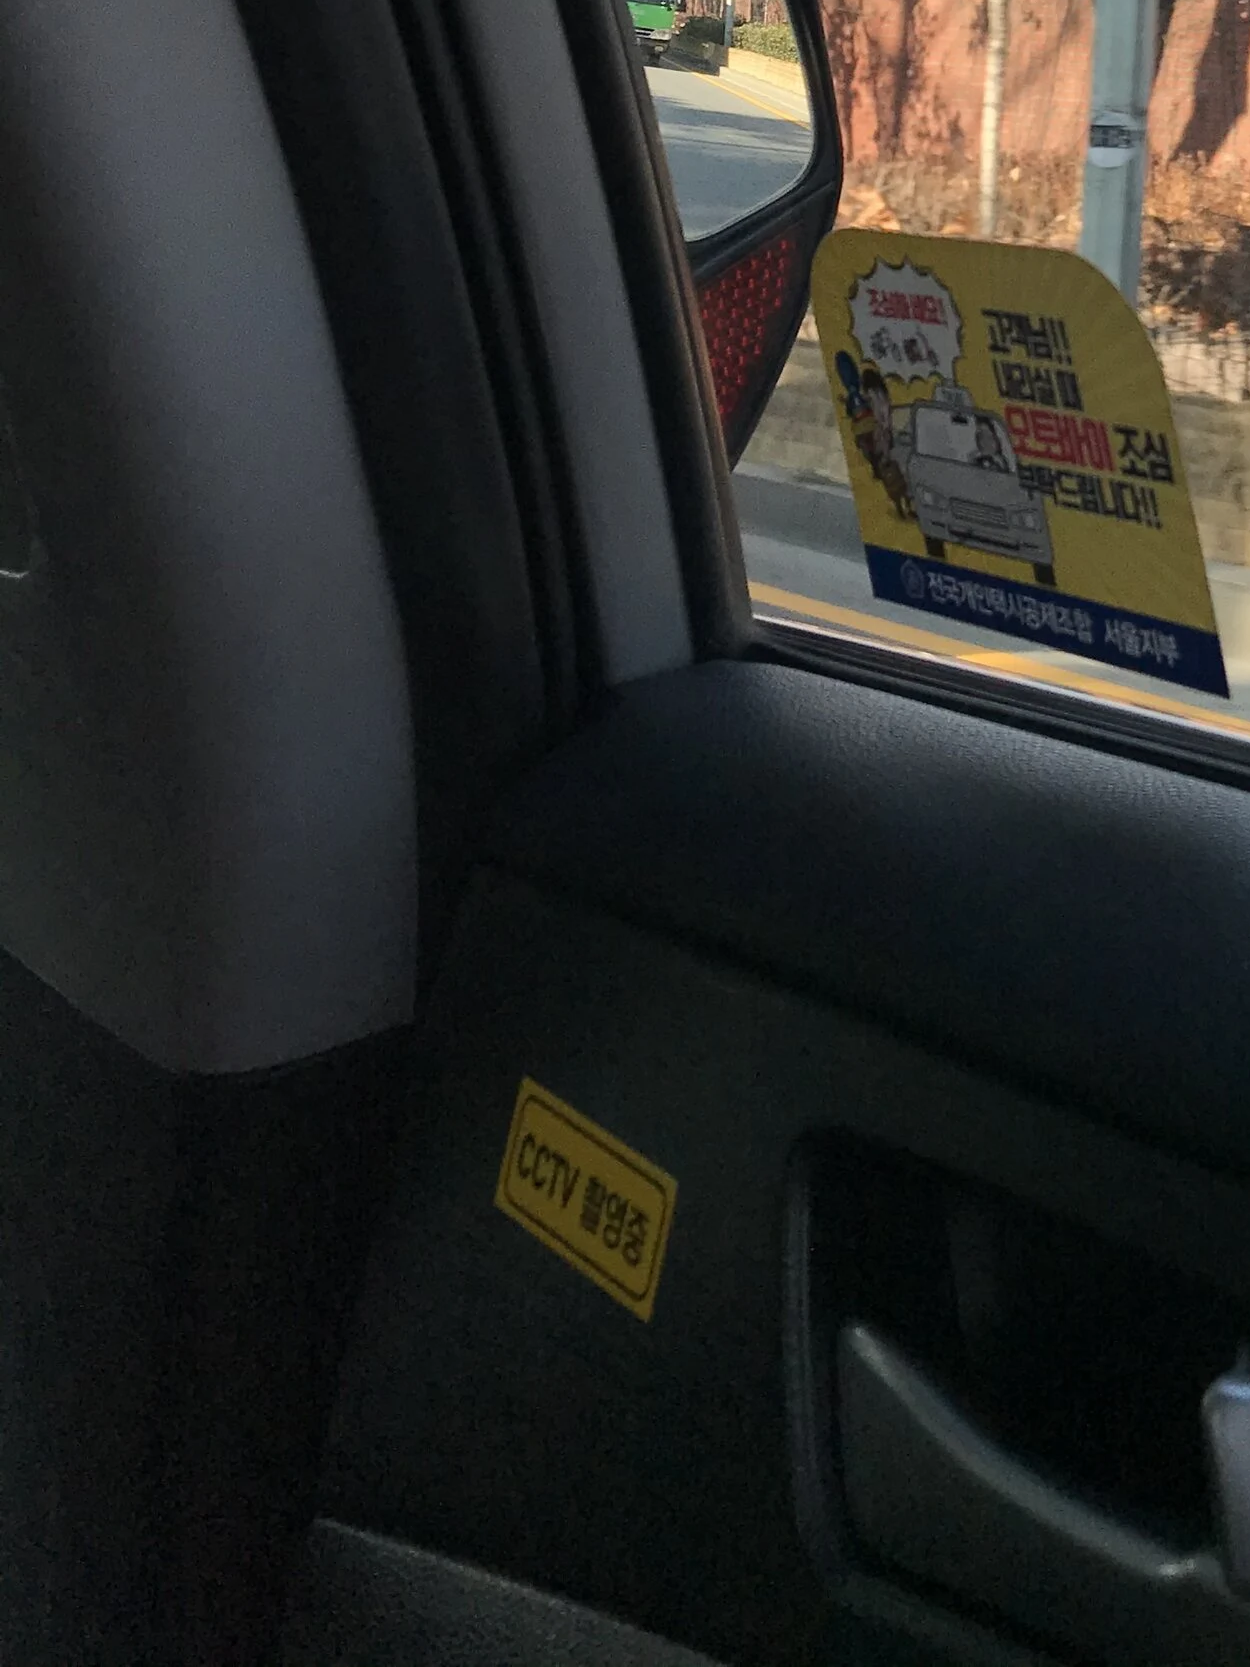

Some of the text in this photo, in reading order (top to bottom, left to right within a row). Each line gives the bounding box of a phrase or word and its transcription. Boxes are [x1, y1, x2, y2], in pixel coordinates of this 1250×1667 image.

[981, 308, 1073, 366] 고객님!!
[1003, 403, 1175, 484] 오토바이 조심
[517, 1132, 580, 1209] CCTV
